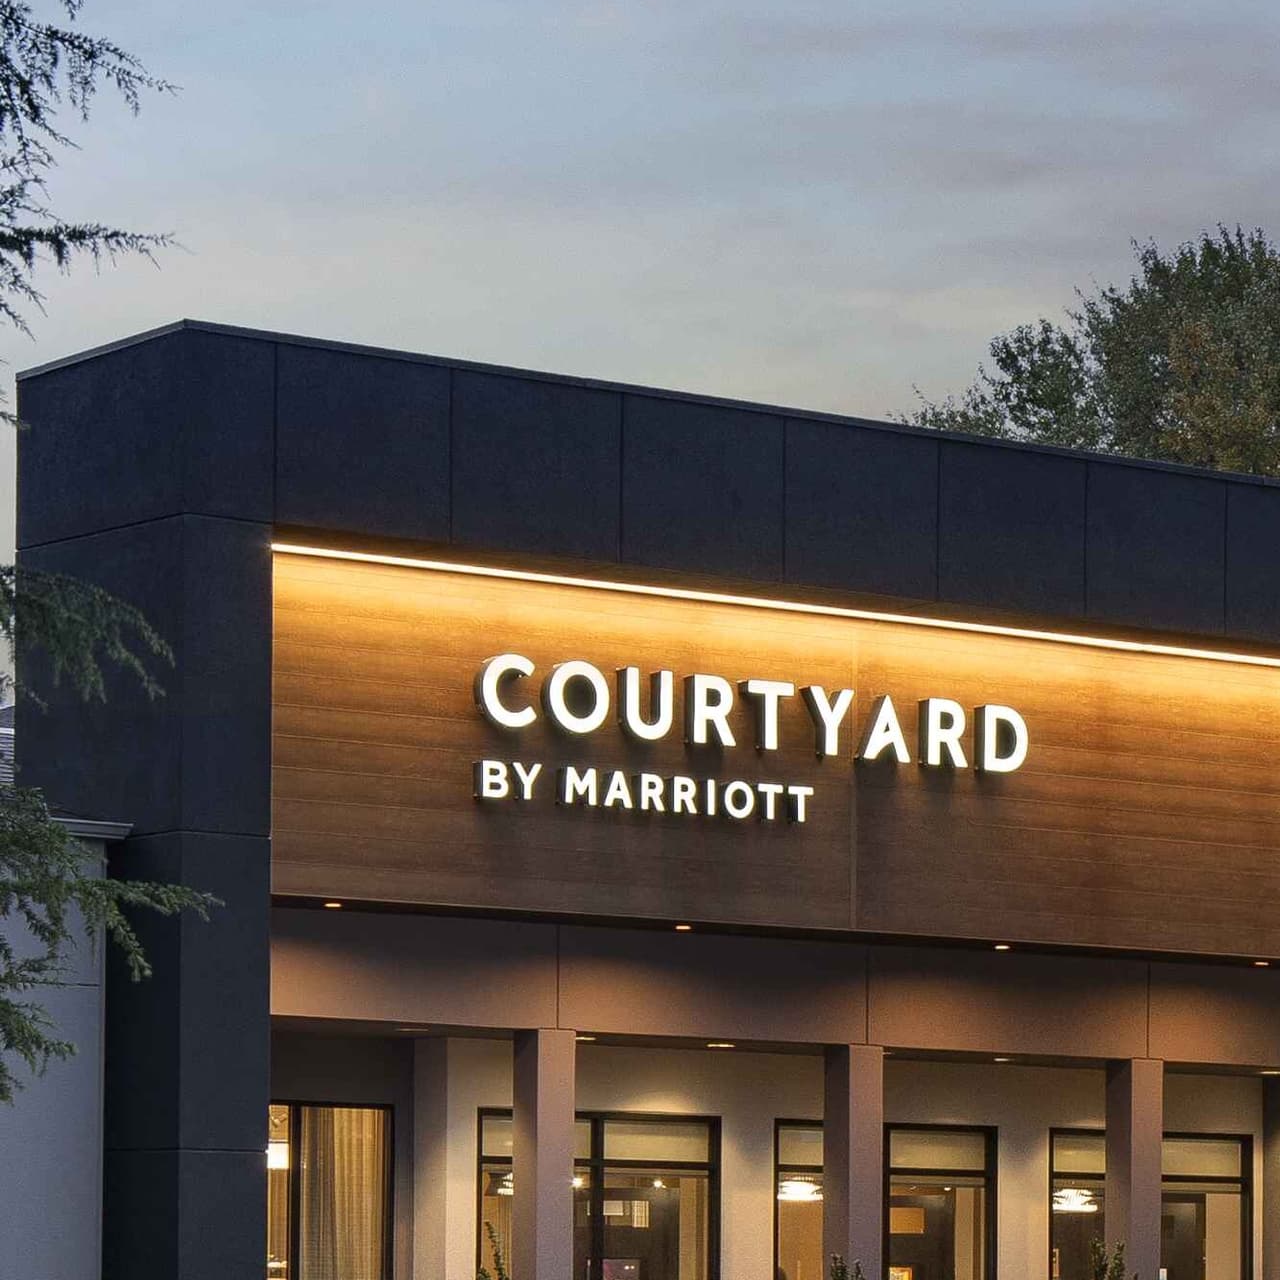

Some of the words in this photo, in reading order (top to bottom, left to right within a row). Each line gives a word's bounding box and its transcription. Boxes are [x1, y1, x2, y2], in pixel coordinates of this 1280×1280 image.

[478, 653, 1029, 773] COURTYARD
[478, 759, 543, 801] BY
[561, 767, 814, 822] MARRIOTT
